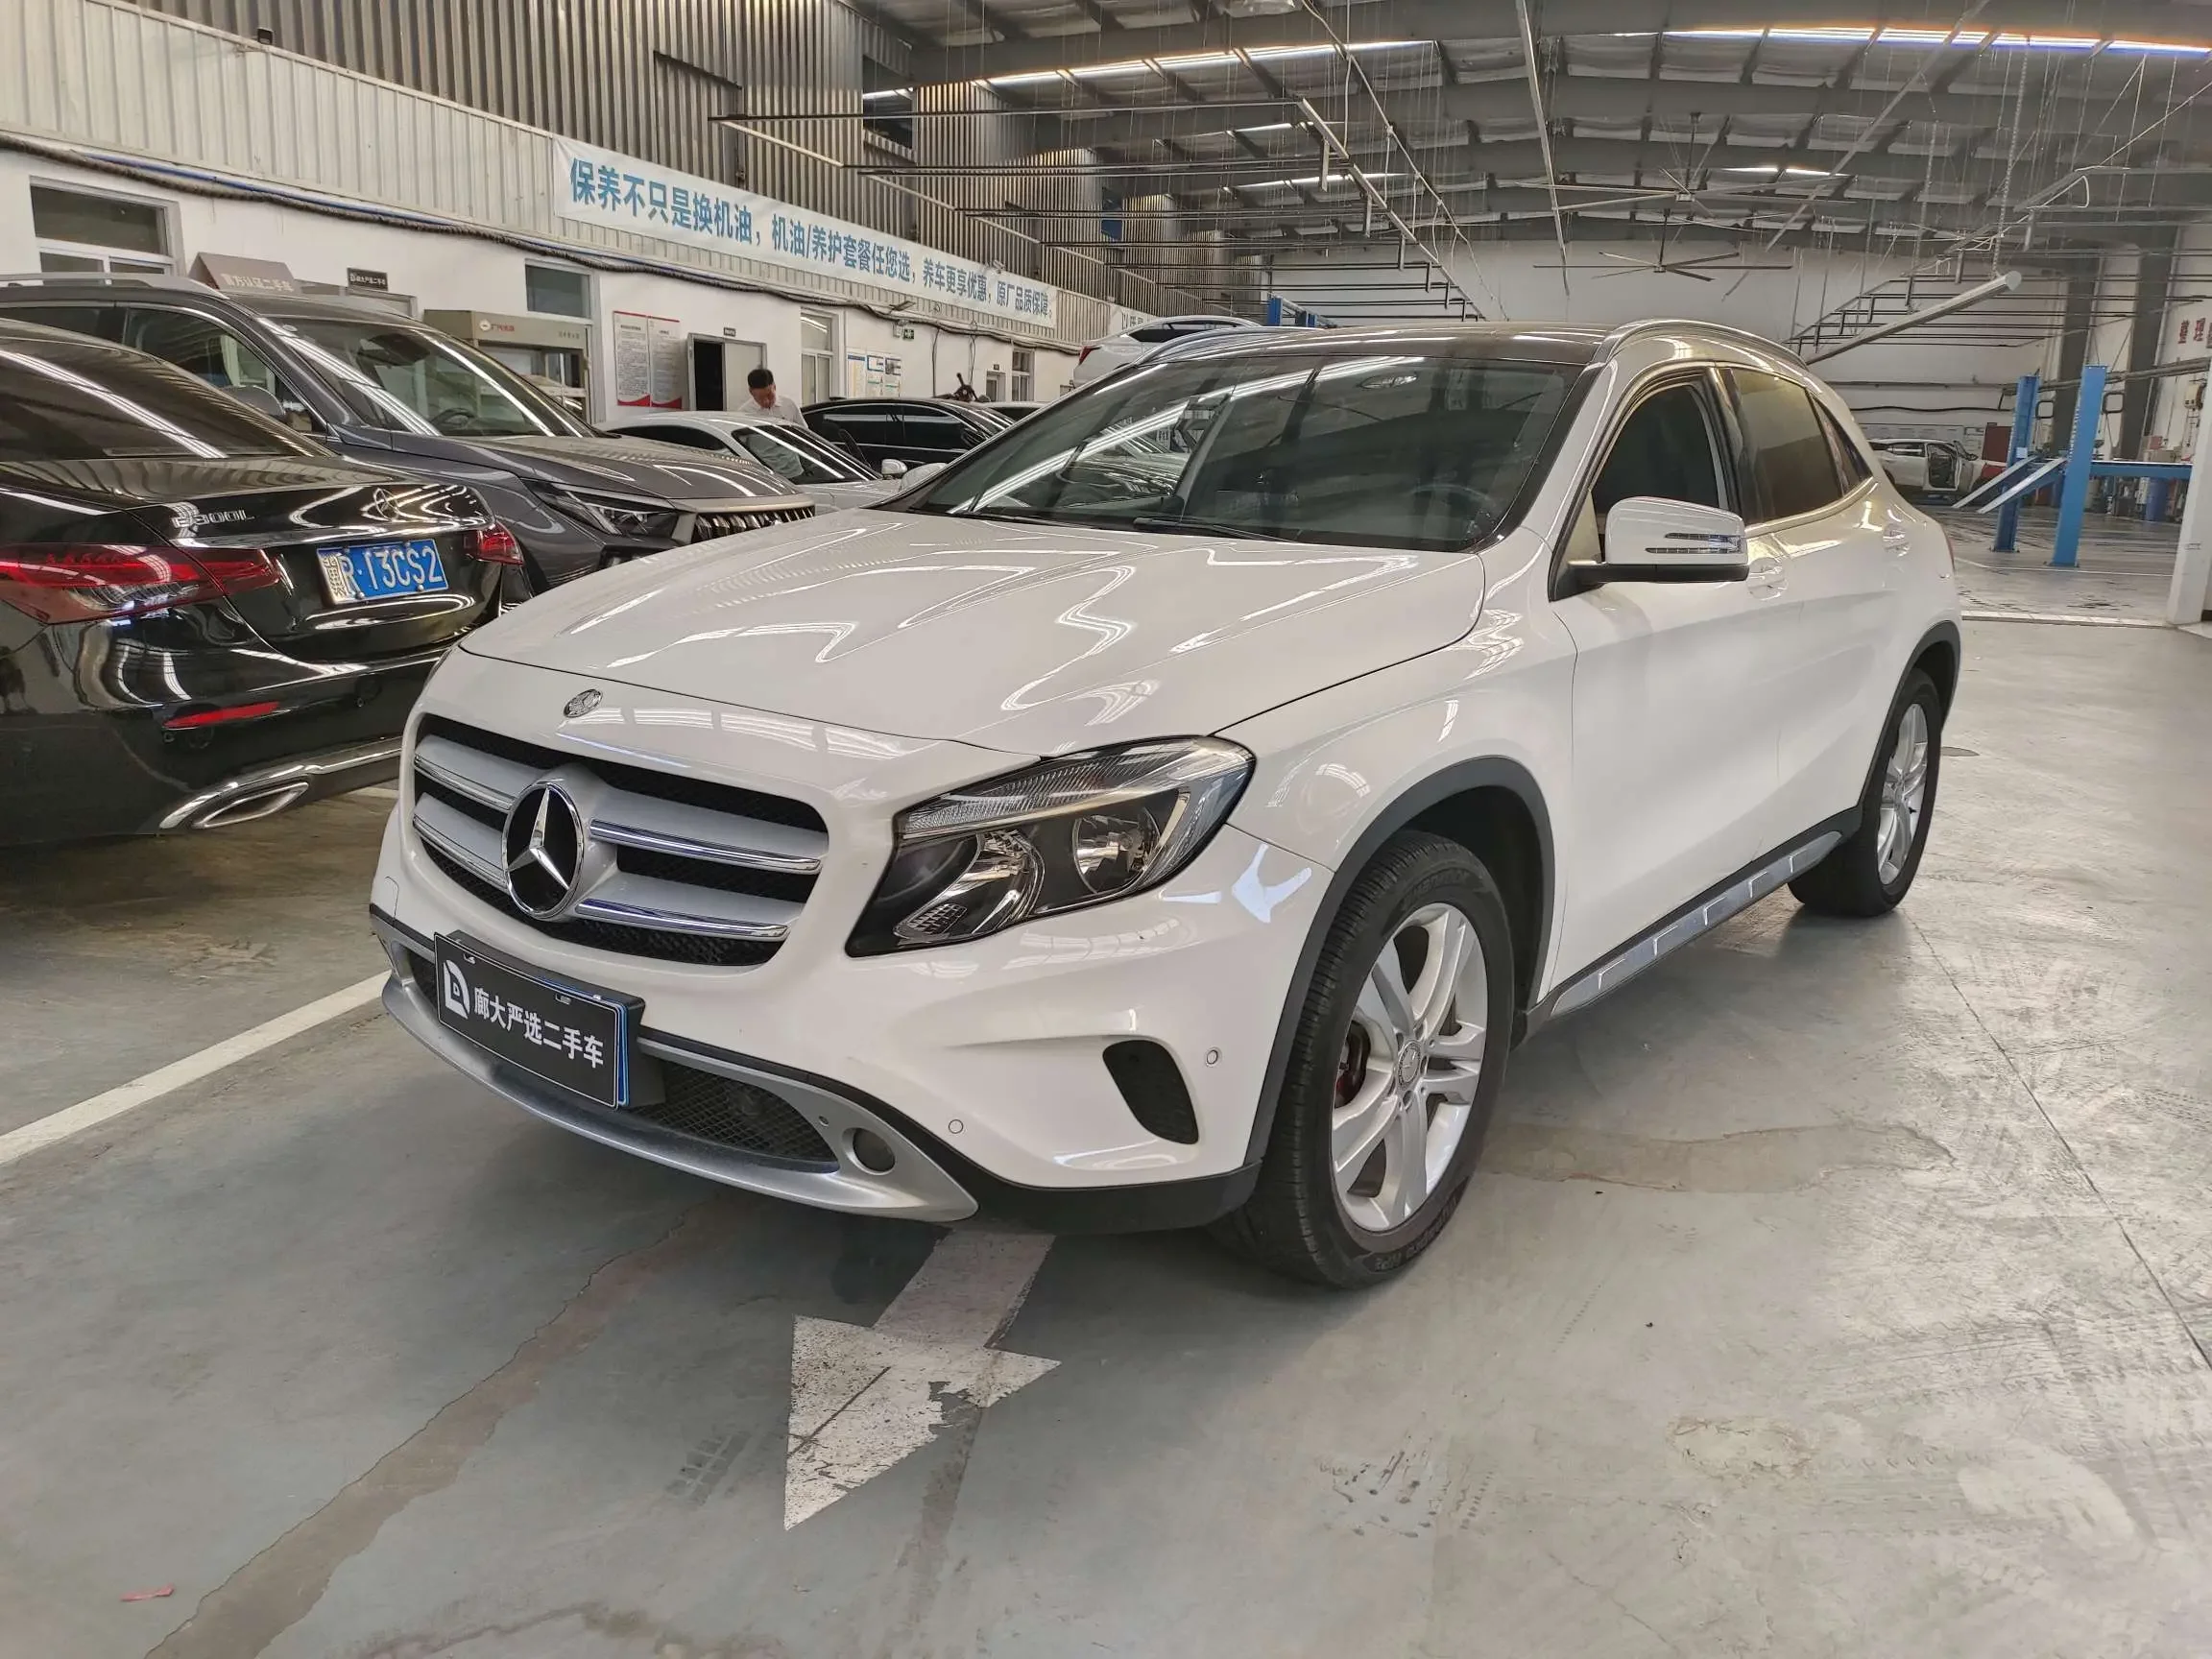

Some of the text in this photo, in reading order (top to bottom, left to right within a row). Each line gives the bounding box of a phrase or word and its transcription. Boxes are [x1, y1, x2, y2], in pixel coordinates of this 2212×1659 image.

[473, 986, 604, 1069] 廊大严选二手车
